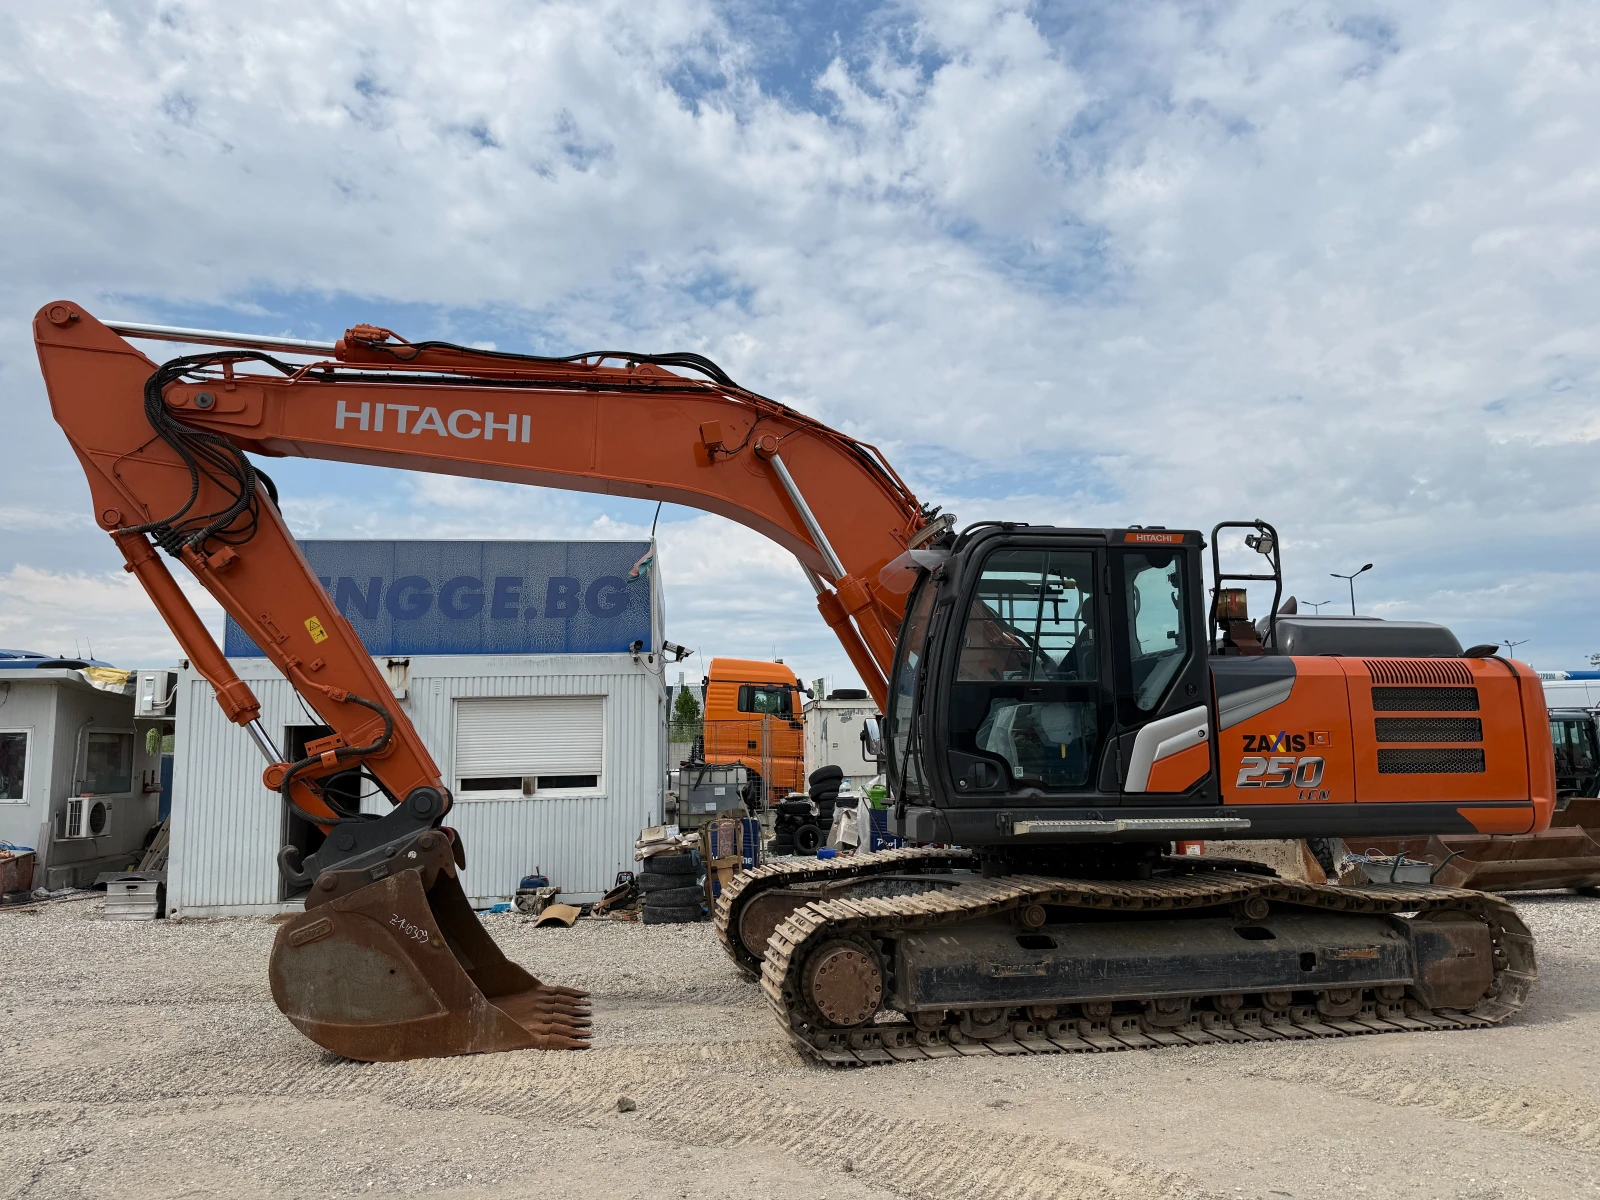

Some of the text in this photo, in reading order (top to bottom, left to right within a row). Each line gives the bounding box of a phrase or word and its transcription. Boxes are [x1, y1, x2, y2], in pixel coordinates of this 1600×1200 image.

[335, 400, 531, 443] HITACHI
[1136, 534, 1172, 542] HITACHI
[318, 576, 630, 620] NGGE.BG
[1242, 731, 1306, 752] ZAXIS
[1235, 756, 1326, 788] 250
[1298, 789, 1331, 800] LCN
